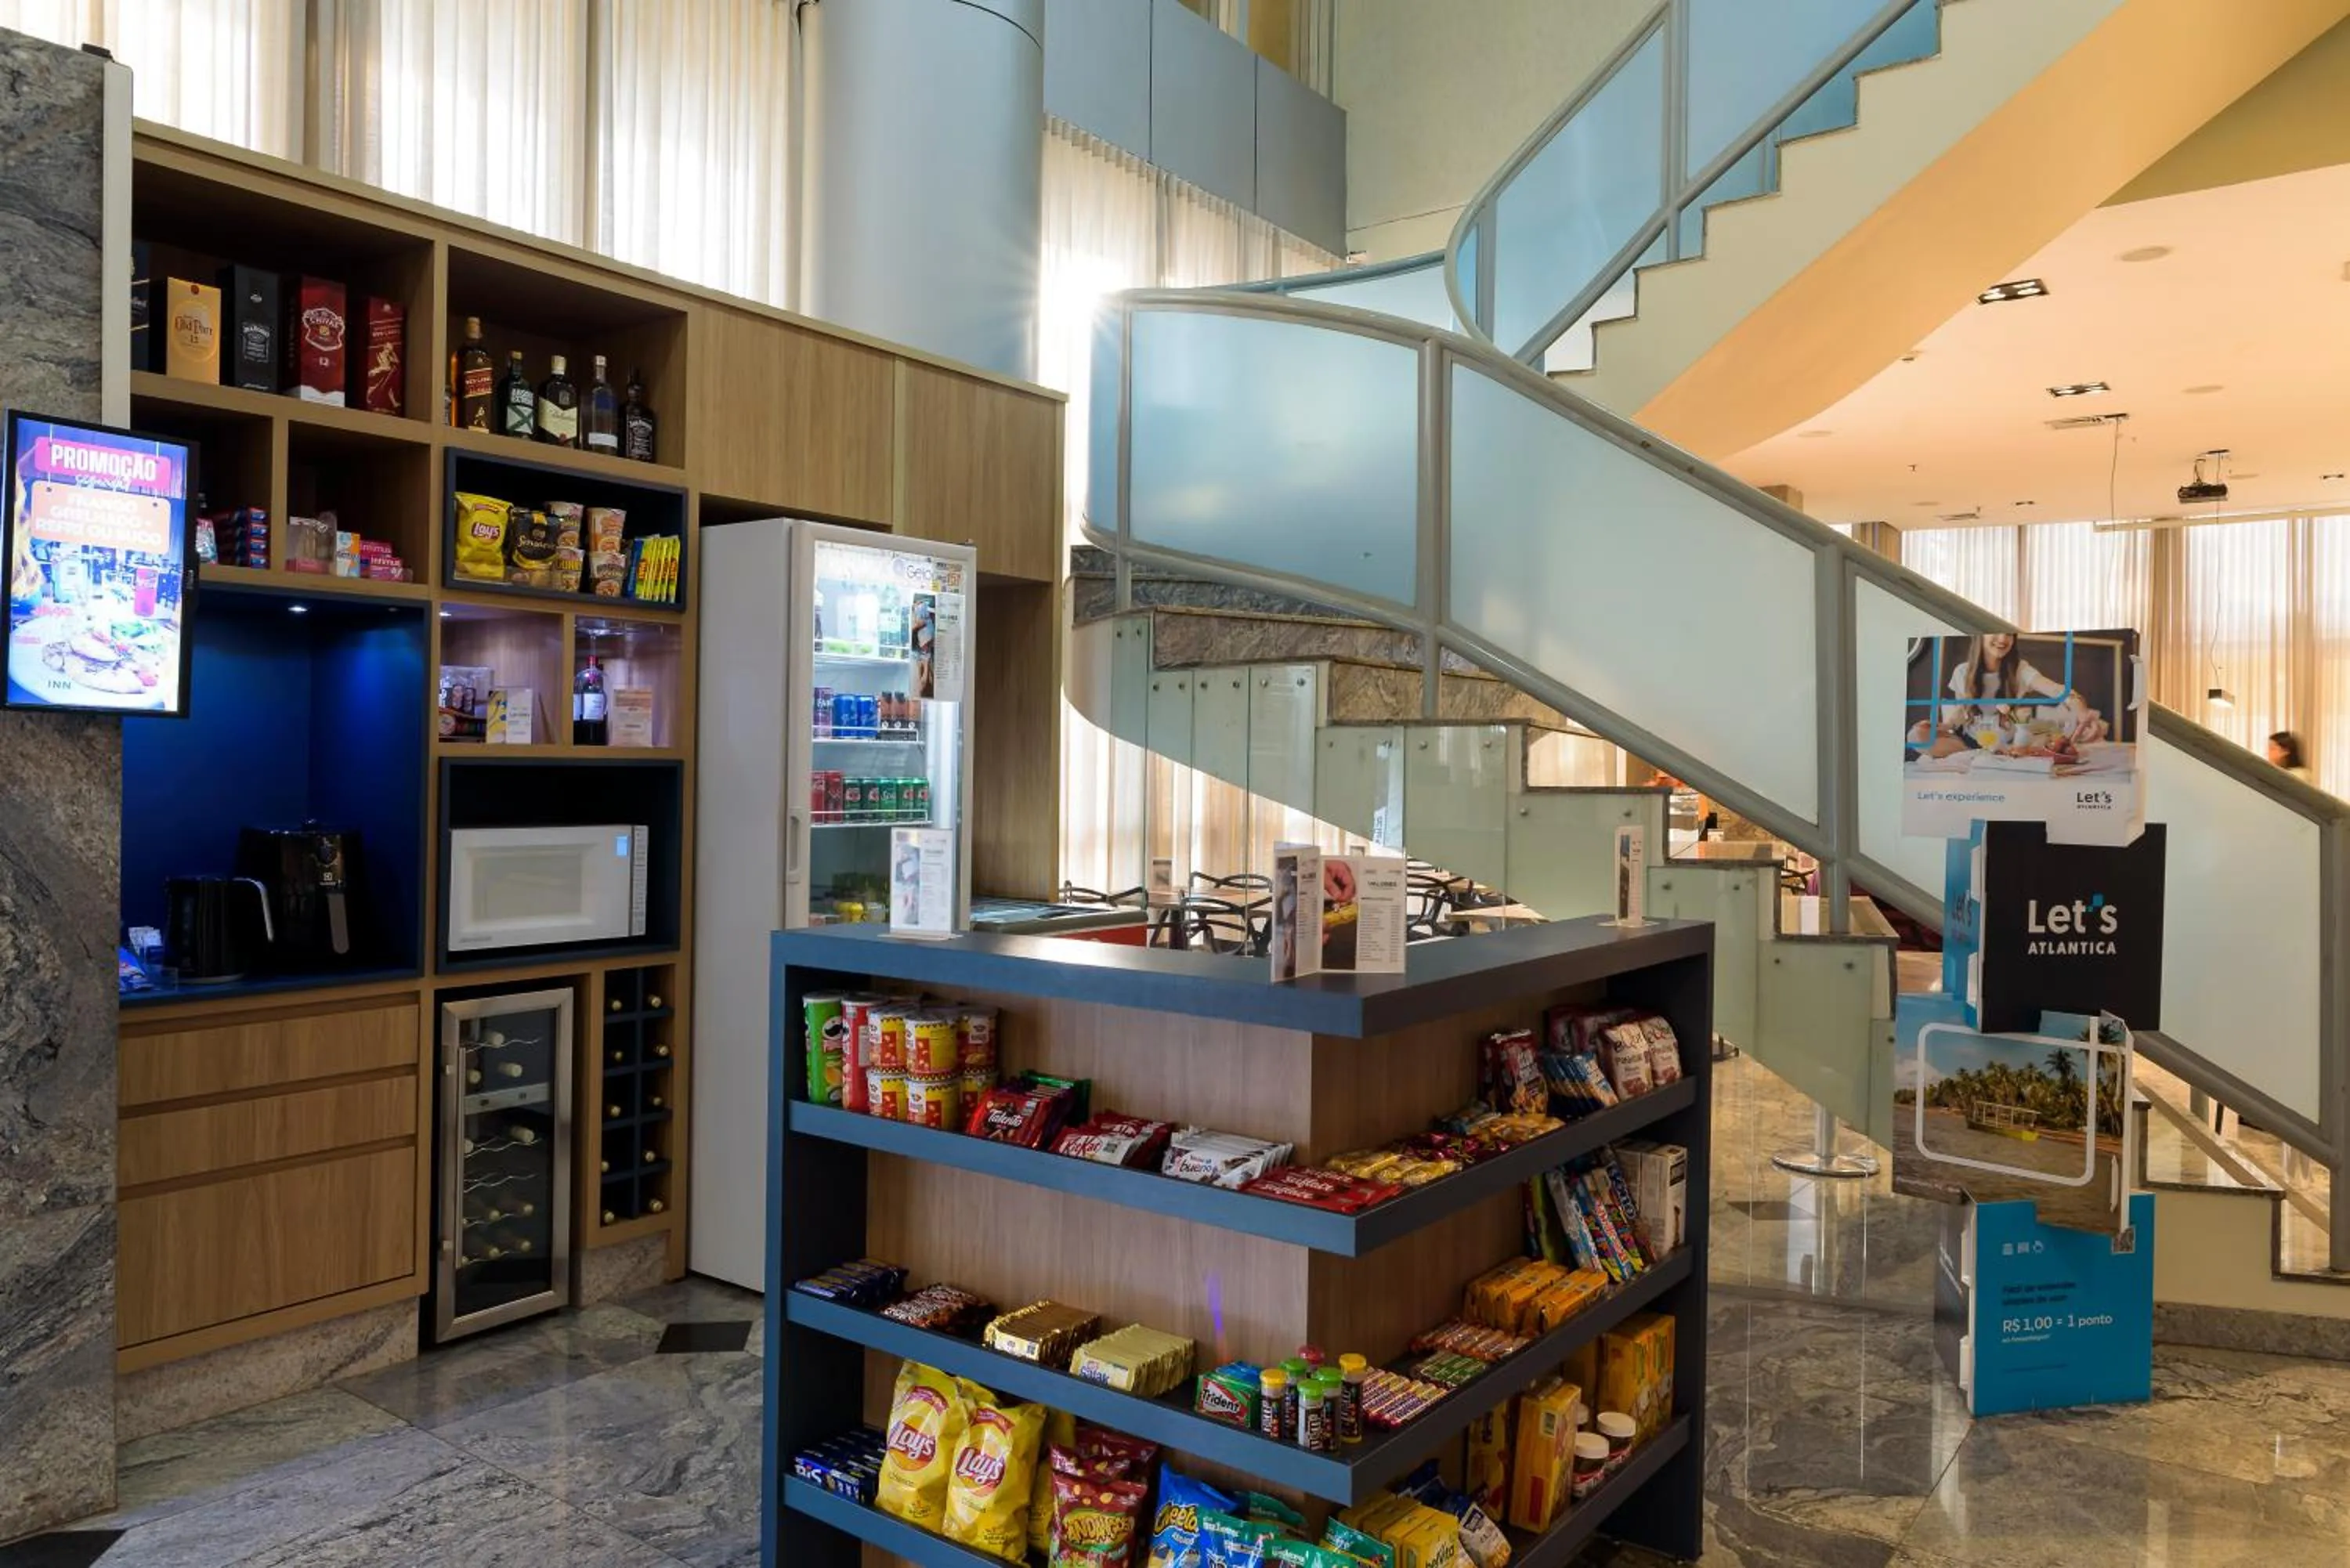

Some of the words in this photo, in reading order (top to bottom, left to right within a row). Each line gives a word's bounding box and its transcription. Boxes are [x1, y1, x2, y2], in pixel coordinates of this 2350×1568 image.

[51, 444, 157, 482] PROMOÇÃO
[1917, 792, 1943, 800] Let's
[1946, 792, 2005, 803] experience
[2077, 791, 2113, 803] Let's
[2028, 893, 2118, 935] Let's
[2027, 941, 2117, 956] ATLANTICA
[2002, 1318, 2020, 1333] R$
[2023, 1316, 2053, 1332] 1,00
[2067, 1313, 2075, 1328] 1
[2078, 1313, 2113, 1328] ponto
[1202, 1387, 1240, 1413] Trident
[889, 1423, 936, 1458] Lay's
[956, 1447, 1005, 1483] Lay's
